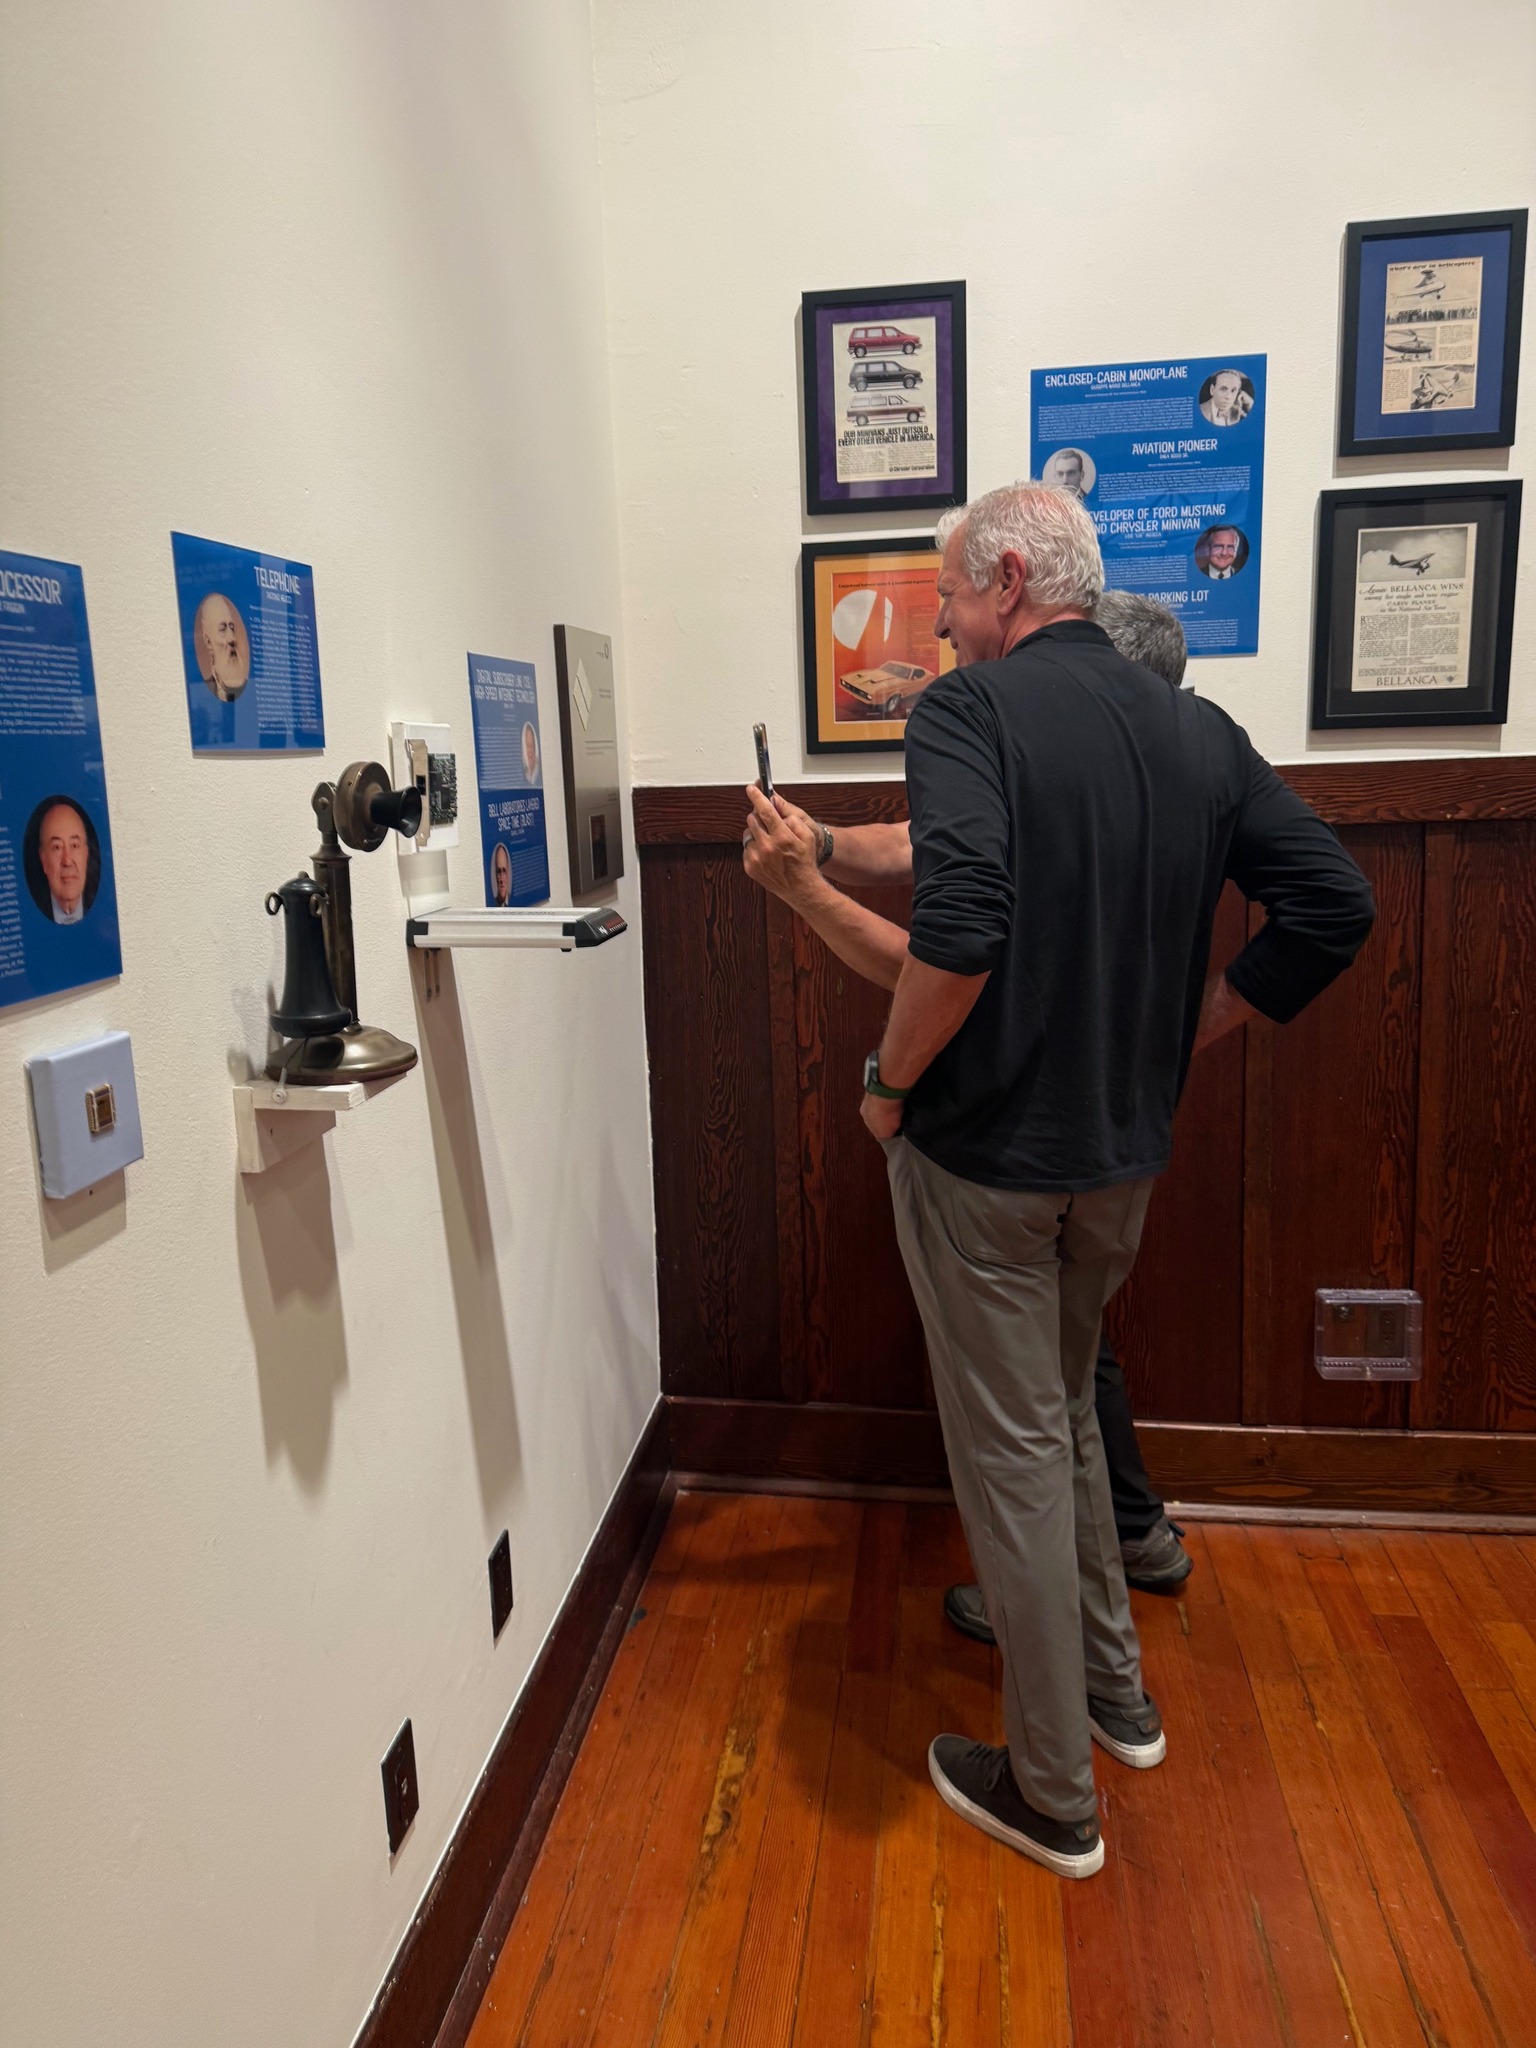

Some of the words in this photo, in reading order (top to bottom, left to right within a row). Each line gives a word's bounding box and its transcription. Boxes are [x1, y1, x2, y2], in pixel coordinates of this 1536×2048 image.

[1129, 366, 1188, 381] MONOPLANE
[843, 430, 856, 438] OUR
[857, 428, 885, 437] MINIVANS
[886, 427, 901, 436] JUST
[902, 425, 929, 435] OUTSOLD
[838, 438, 856, 447] EVERY
[856, 436, 875, 446] OTHER
[876, 434, 898, 444] VEHICLE
[1090, 509, 1134, 523] EVELOPER
[1137, 508, 1149, 520] OF
[1153, 506, 1177, 519] FORD
[1181, 504, 1226, 517] MUSTANG
[1096, 523, 1107, 535] ND
[1110, 520, 1158, 534] CHRYSLER
[254, 566, 301, 595] TELEPHONE
[1390, 584, 1436, 593] BELLANCA
[1191, 590, 1209, 602] LOT
[1376, 676, 1437, 686] BELLANCA
